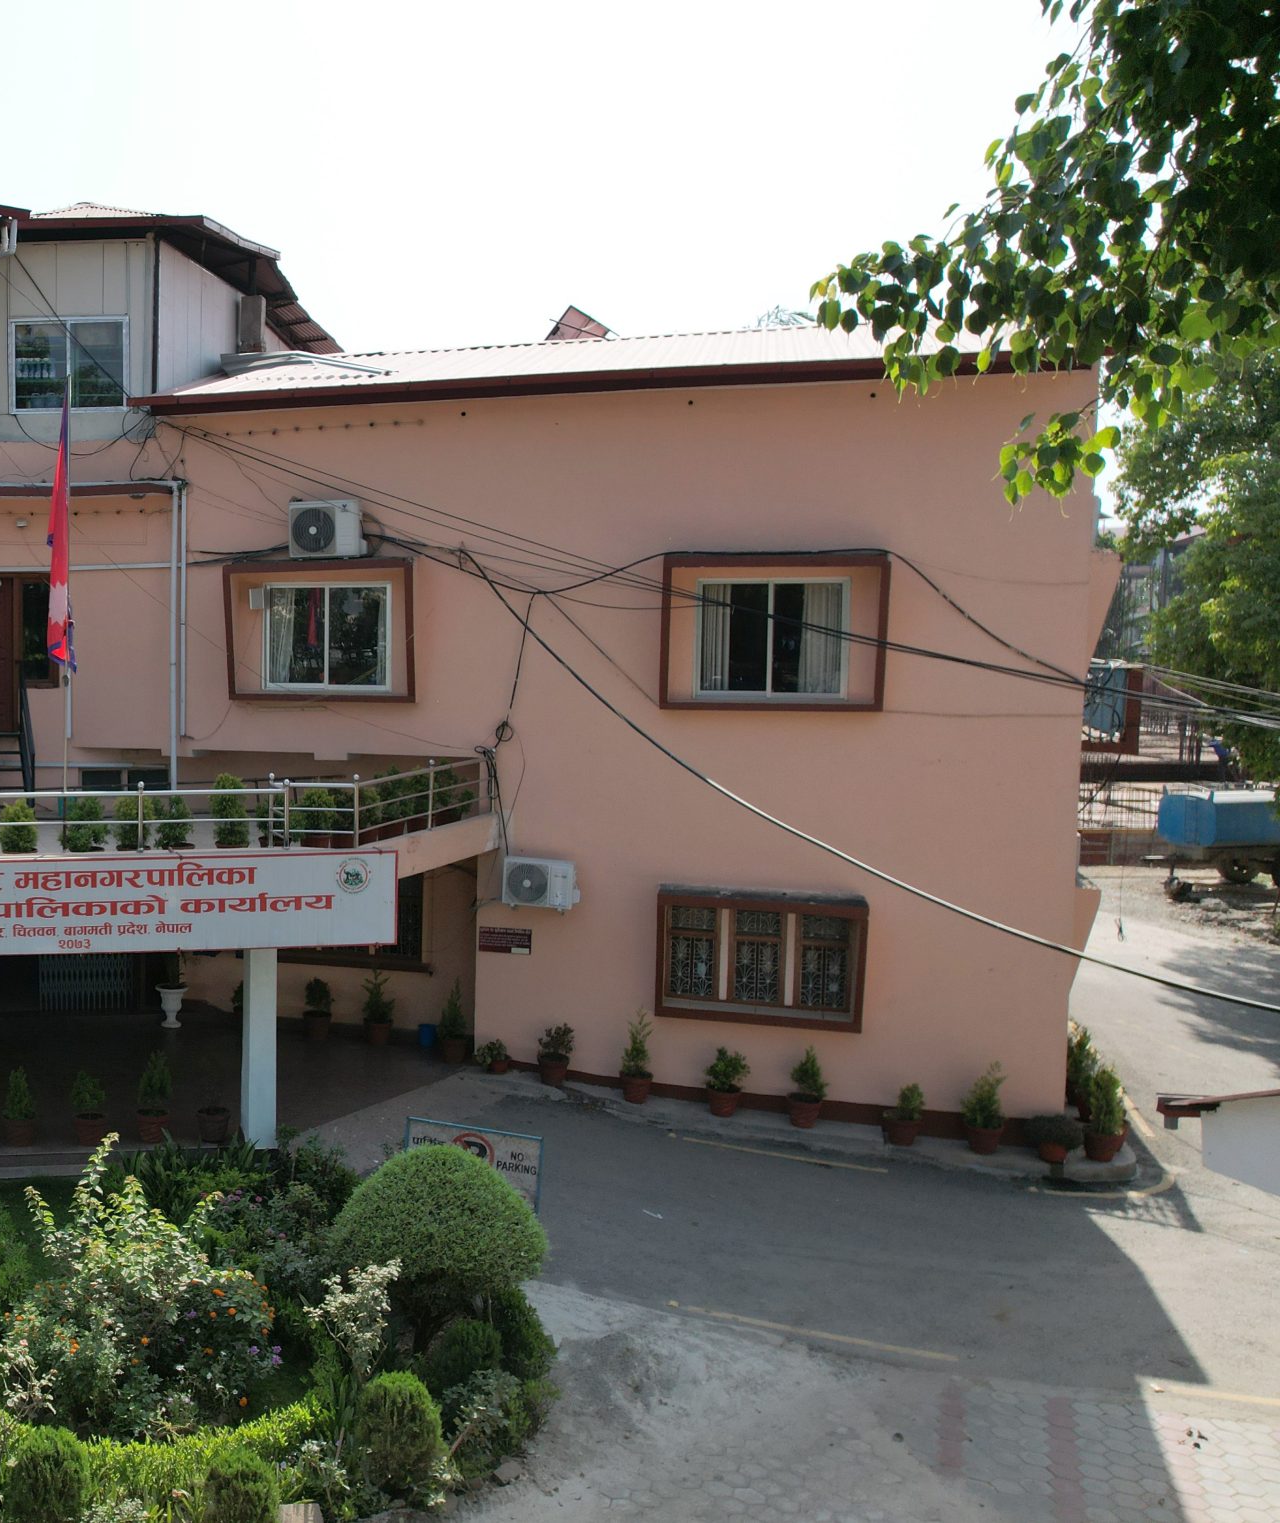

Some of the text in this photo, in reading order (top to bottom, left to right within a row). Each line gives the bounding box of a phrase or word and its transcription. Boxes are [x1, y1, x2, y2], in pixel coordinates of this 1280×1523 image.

[14, 862, 258, 892] महानगरपालिका
[180, 892, 336, 914] कार्यालय
[63, 921, 113, 937] बागमती
[155, 921, 193, 934] नेपाल
[58, 938, 91, 950] २०७३
[510, 1151, 525, 1162] NO
[496, 1160, 537, 1176] PARKING
